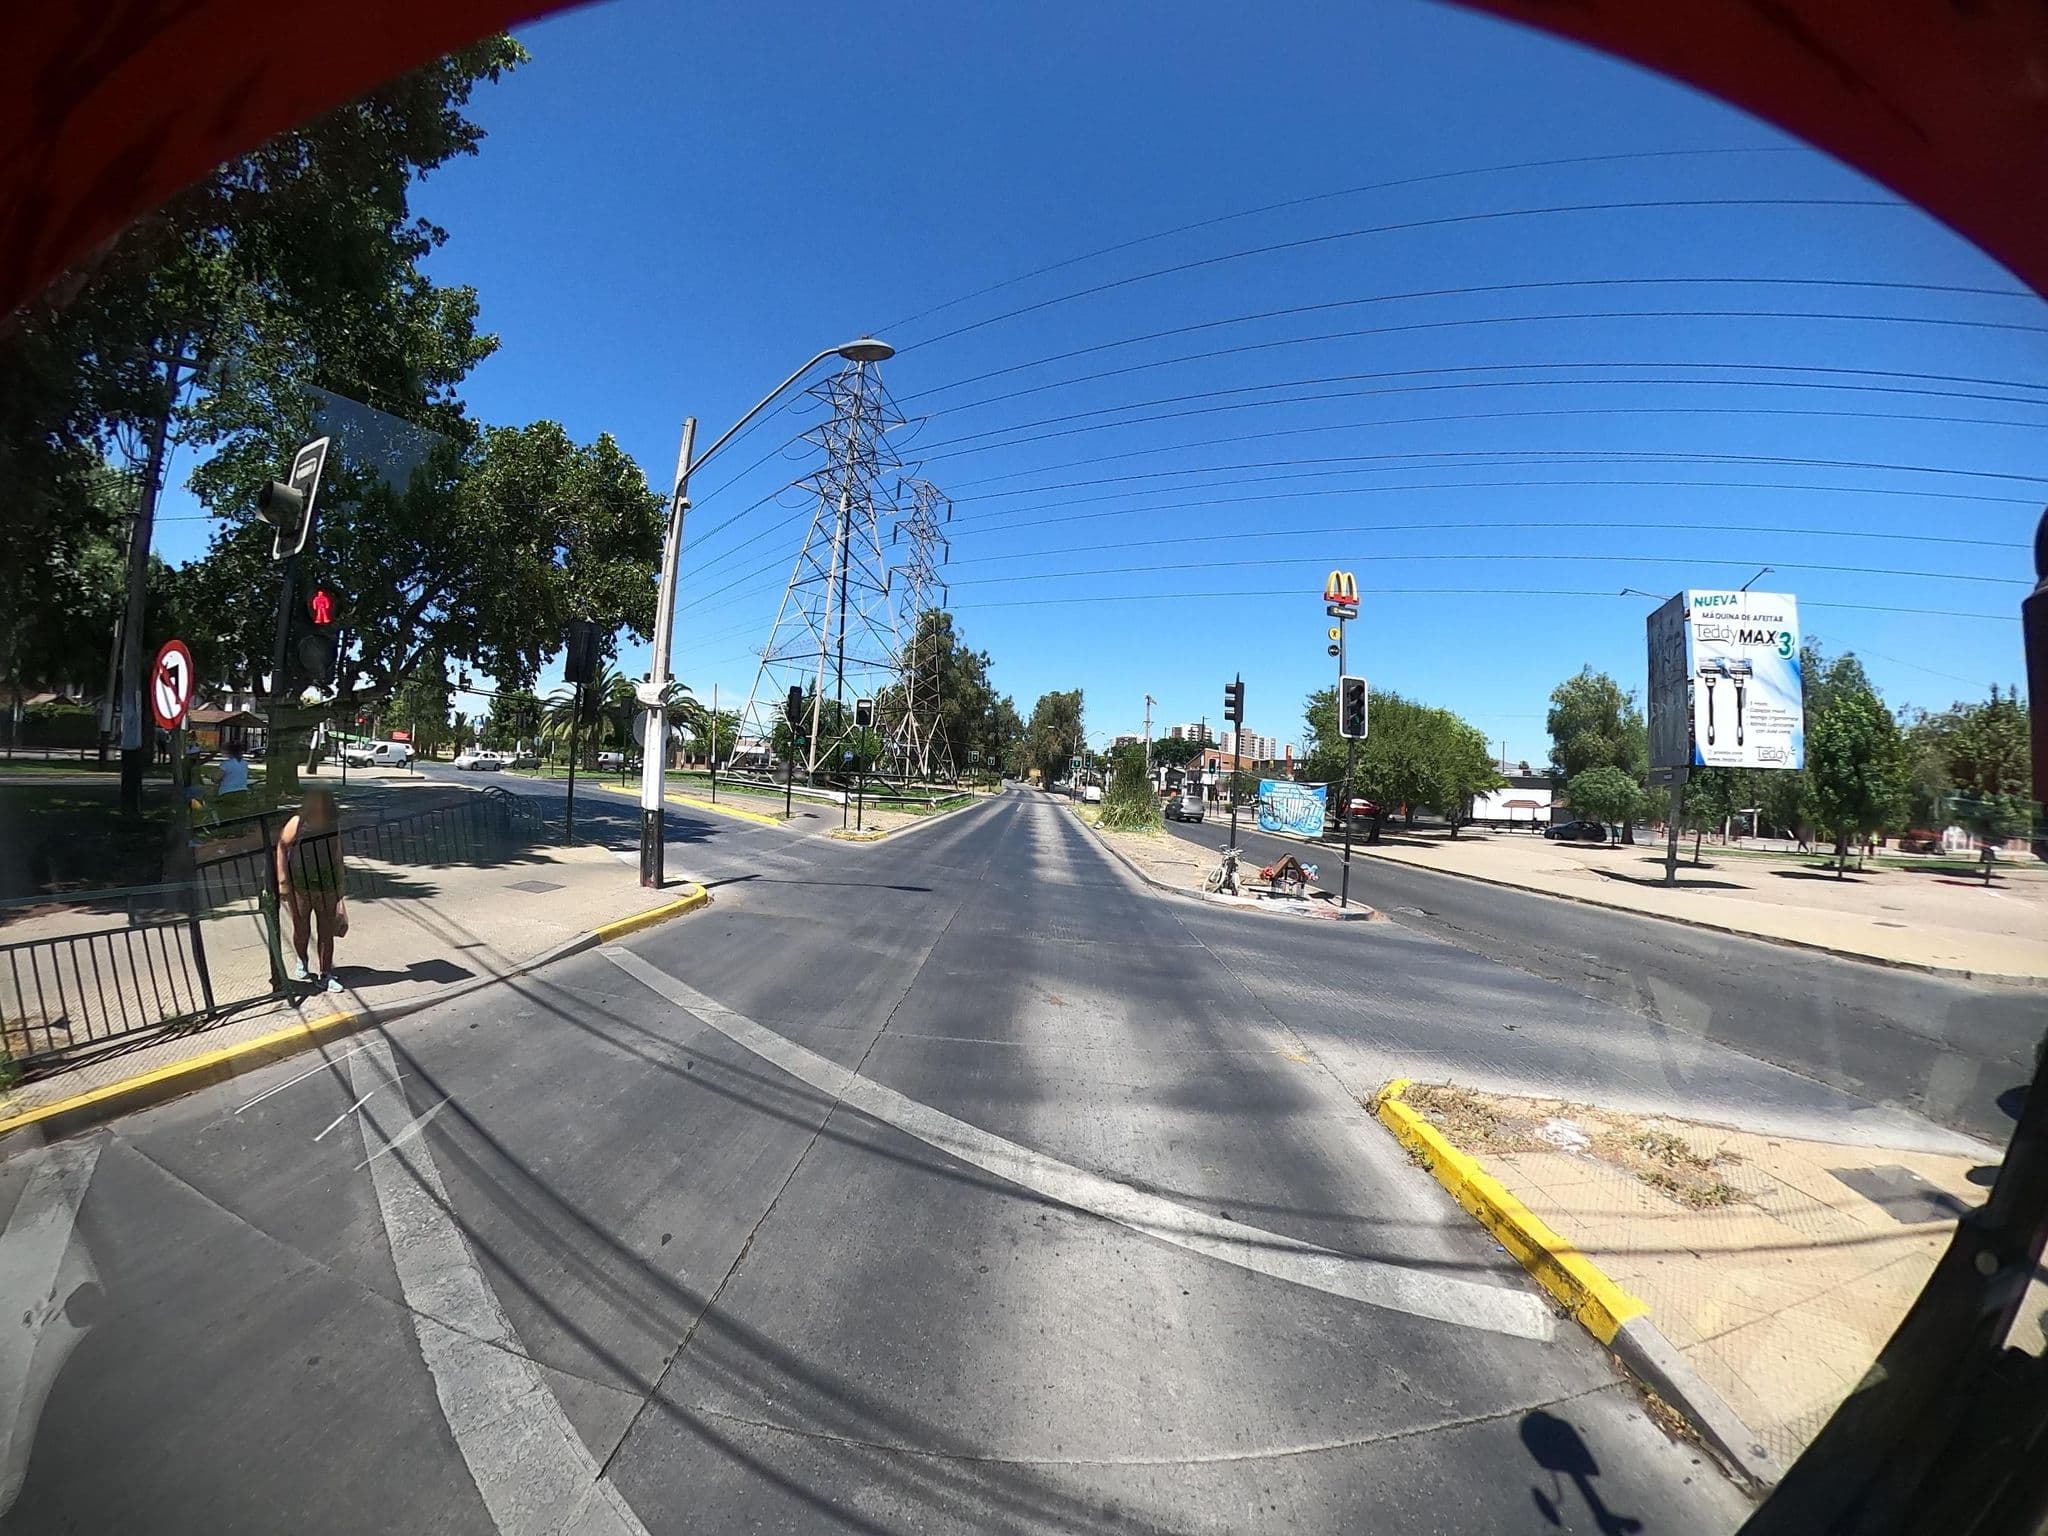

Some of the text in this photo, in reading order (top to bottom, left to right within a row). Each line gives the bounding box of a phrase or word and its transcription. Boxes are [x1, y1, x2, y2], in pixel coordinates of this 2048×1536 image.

[1694, 595, 1738, 607] NUEVA
[1702, 610, 1739, 620] MÁQUINA
[1694, 624, 1738, 646] Teddy
